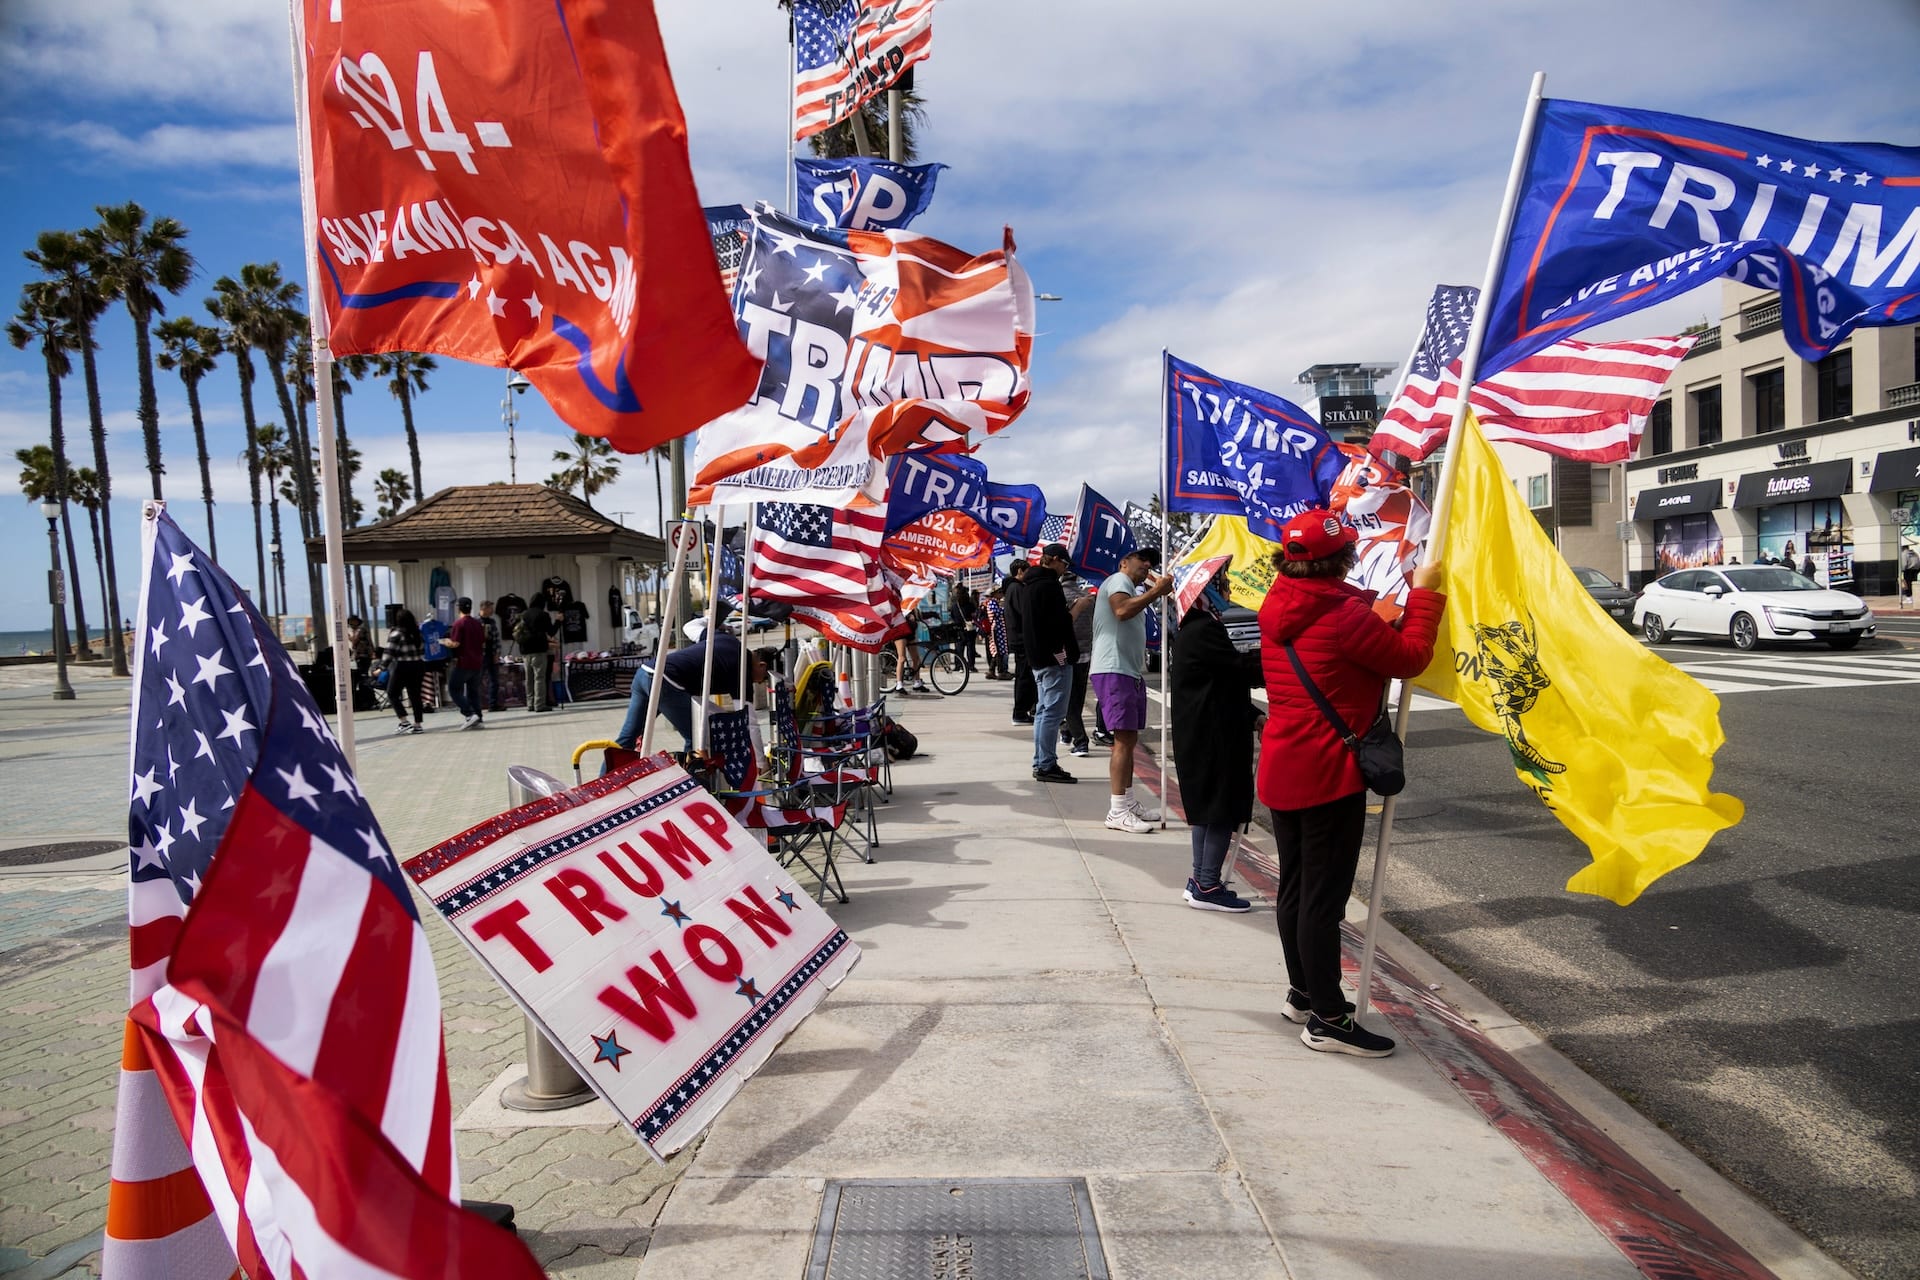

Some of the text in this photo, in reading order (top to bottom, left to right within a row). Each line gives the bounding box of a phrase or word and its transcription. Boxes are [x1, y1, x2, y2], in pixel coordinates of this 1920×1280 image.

[335, 50, 513, 175] 24-
[812, 173, 907, 230] STP
[1593, 151, 1920, 289] TRUM
[321, 209, 387, 266] SAVE
[856, 282, 898, 318] #47
[1325, 409, 1374, 421] STRAND
[1186, 470, 1223, 487] SAVE
[1269, 499, 1310, 519] GAIN
[1658, 495, 1691, 507] DAKINE
[899, 531, 948, 551] AMERICA
[911, 512, 963, 535] 024-
[471, 801, 733, 974] TRUMP
[597, 885, 793, 1043] WON
